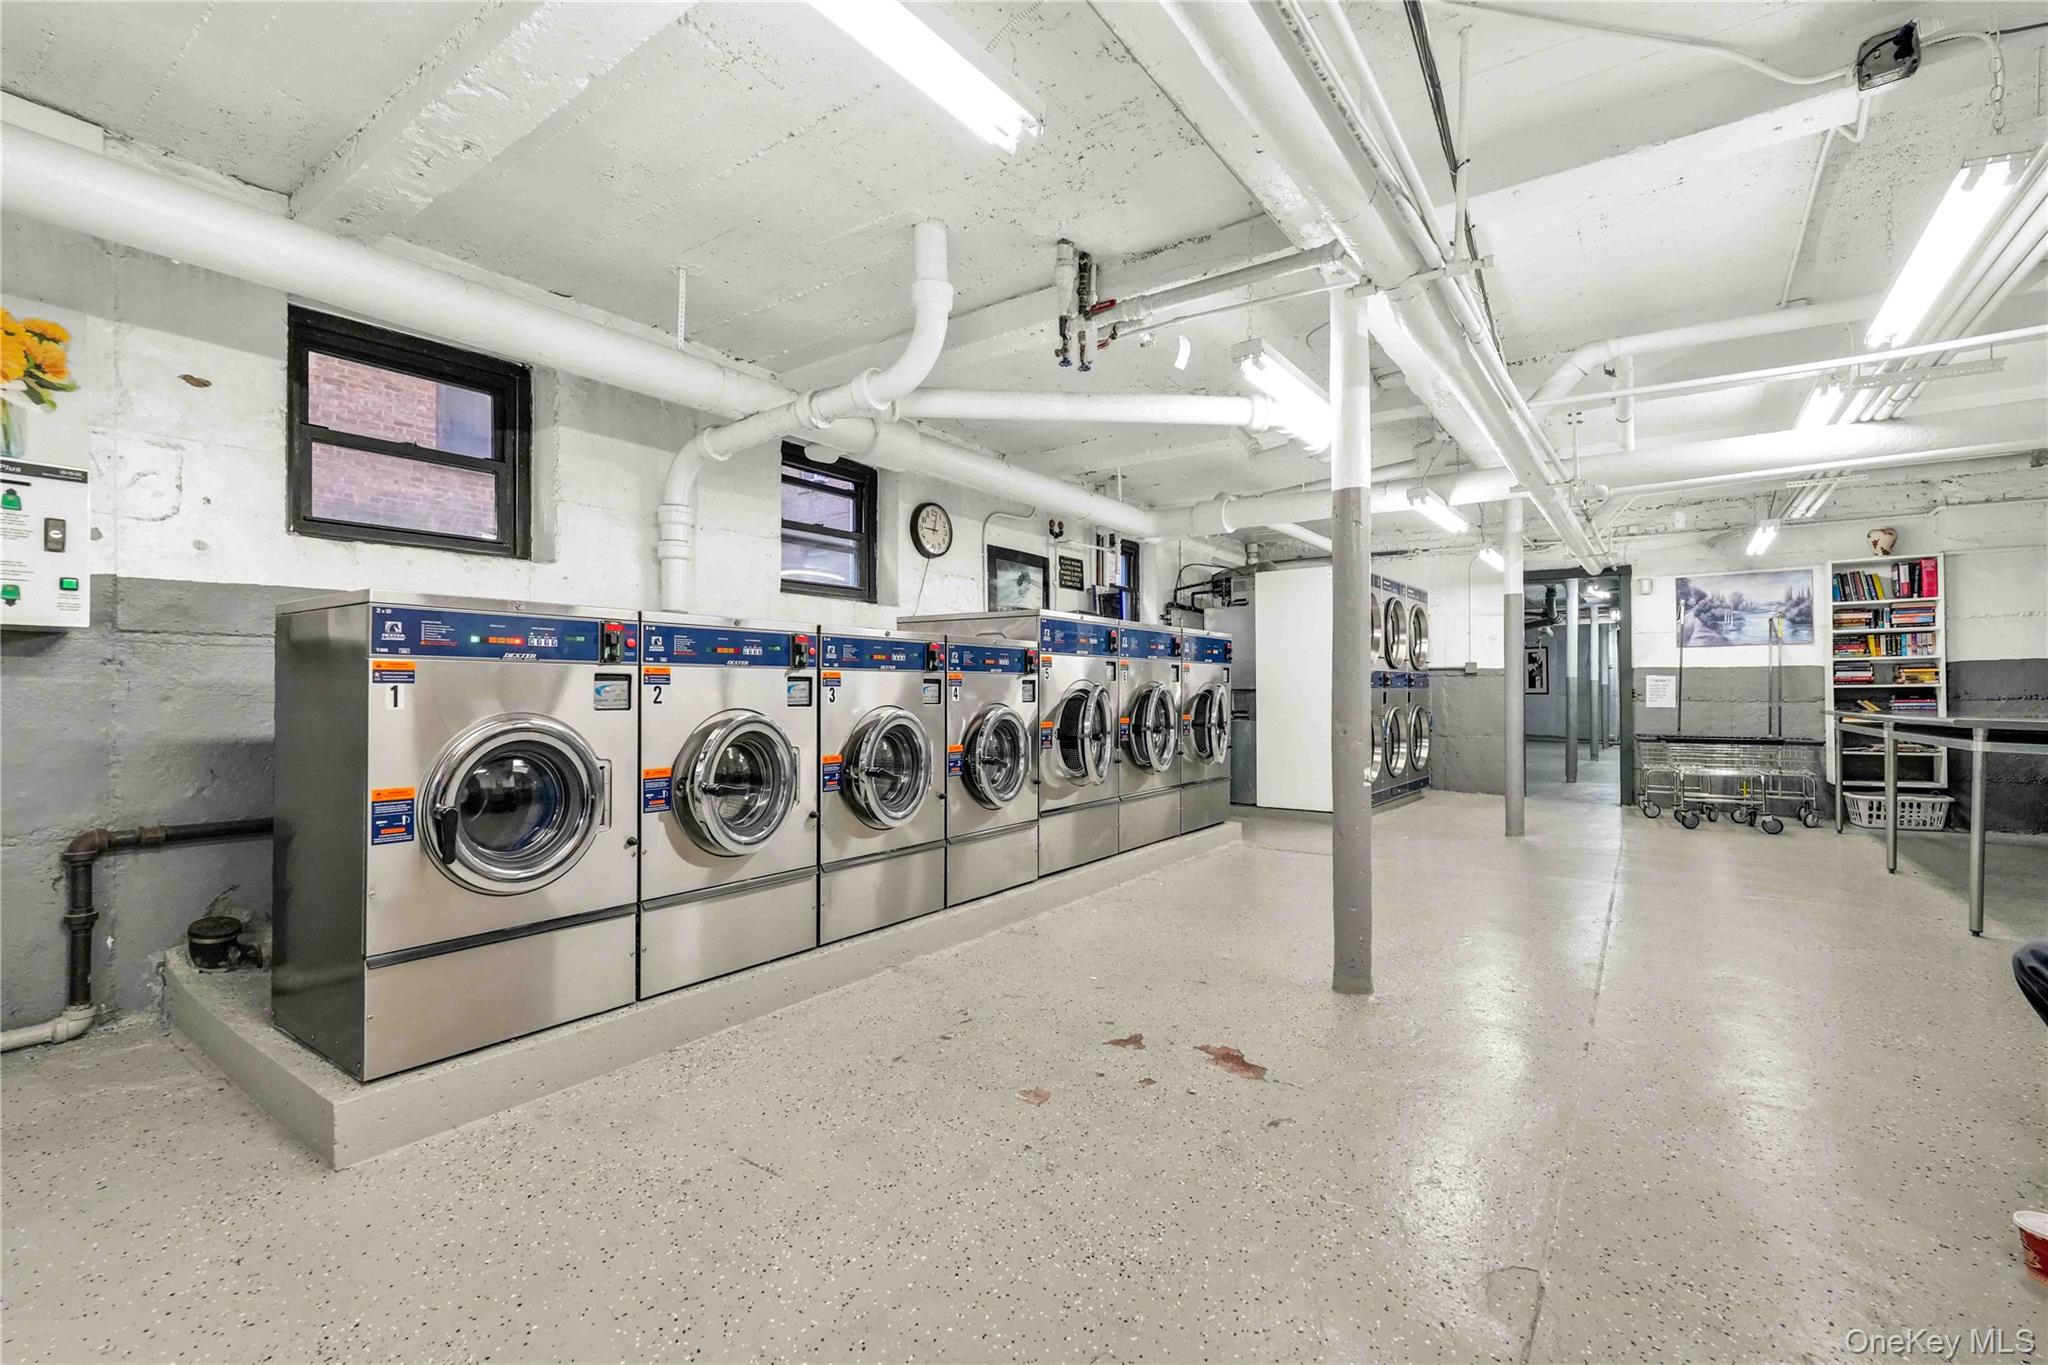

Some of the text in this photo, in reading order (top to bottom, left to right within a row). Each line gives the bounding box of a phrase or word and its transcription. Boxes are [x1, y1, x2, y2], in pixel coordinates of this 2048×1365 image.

[1044, 668, 1050, 680] 5
[390, 685, 398, 708] 1
[653, 686, 662, 704] 2
[829, 687, 836, 703] 3
[953, 687, 958, 700] 4
